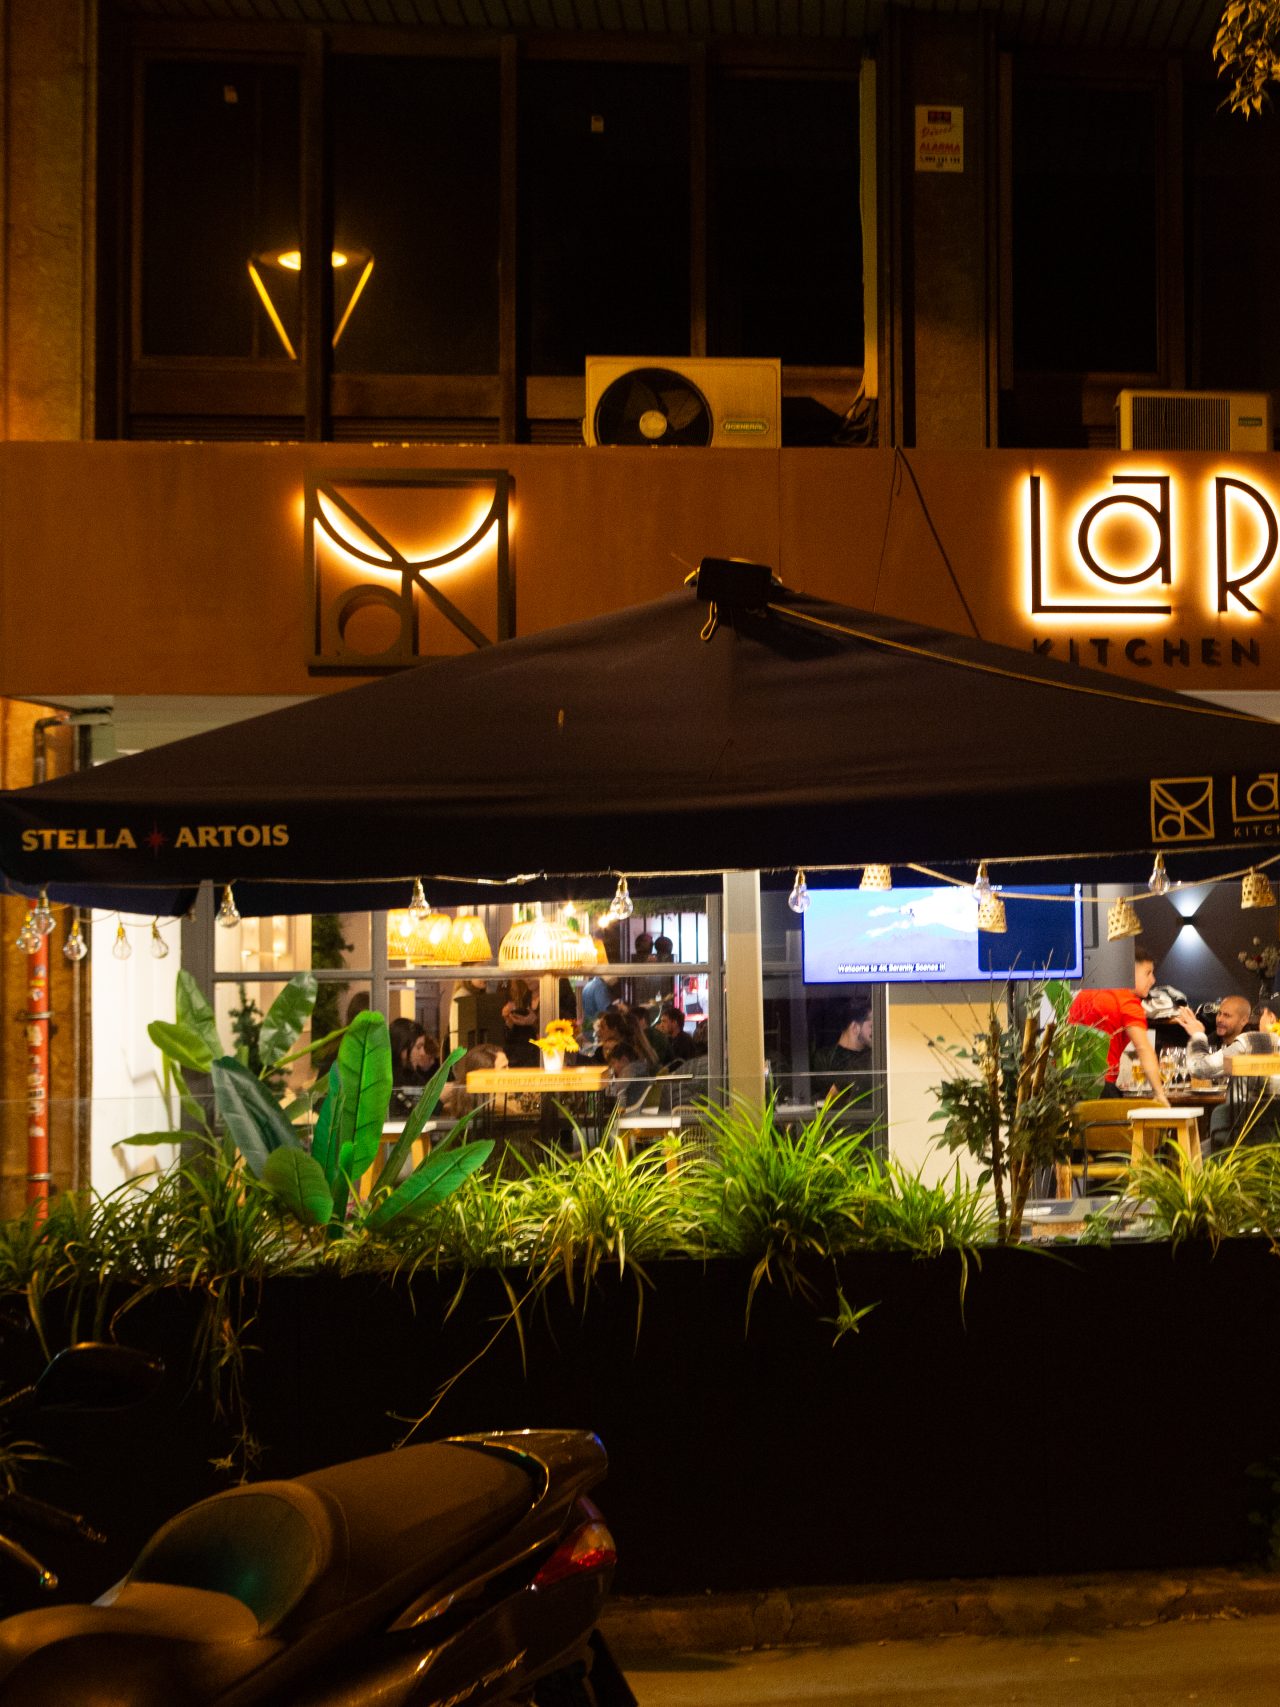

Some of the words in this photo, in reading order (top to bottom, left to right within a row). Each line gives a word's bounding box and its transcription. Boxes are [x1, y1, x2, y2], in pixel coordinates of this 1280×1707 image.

[1032, 637, 1262, 668] KITCHEN
[21, 828, 138, 851] STELLA
[174, 824, 290, 848] ARTOIS
[838, 963, 869, 974] Welcome
